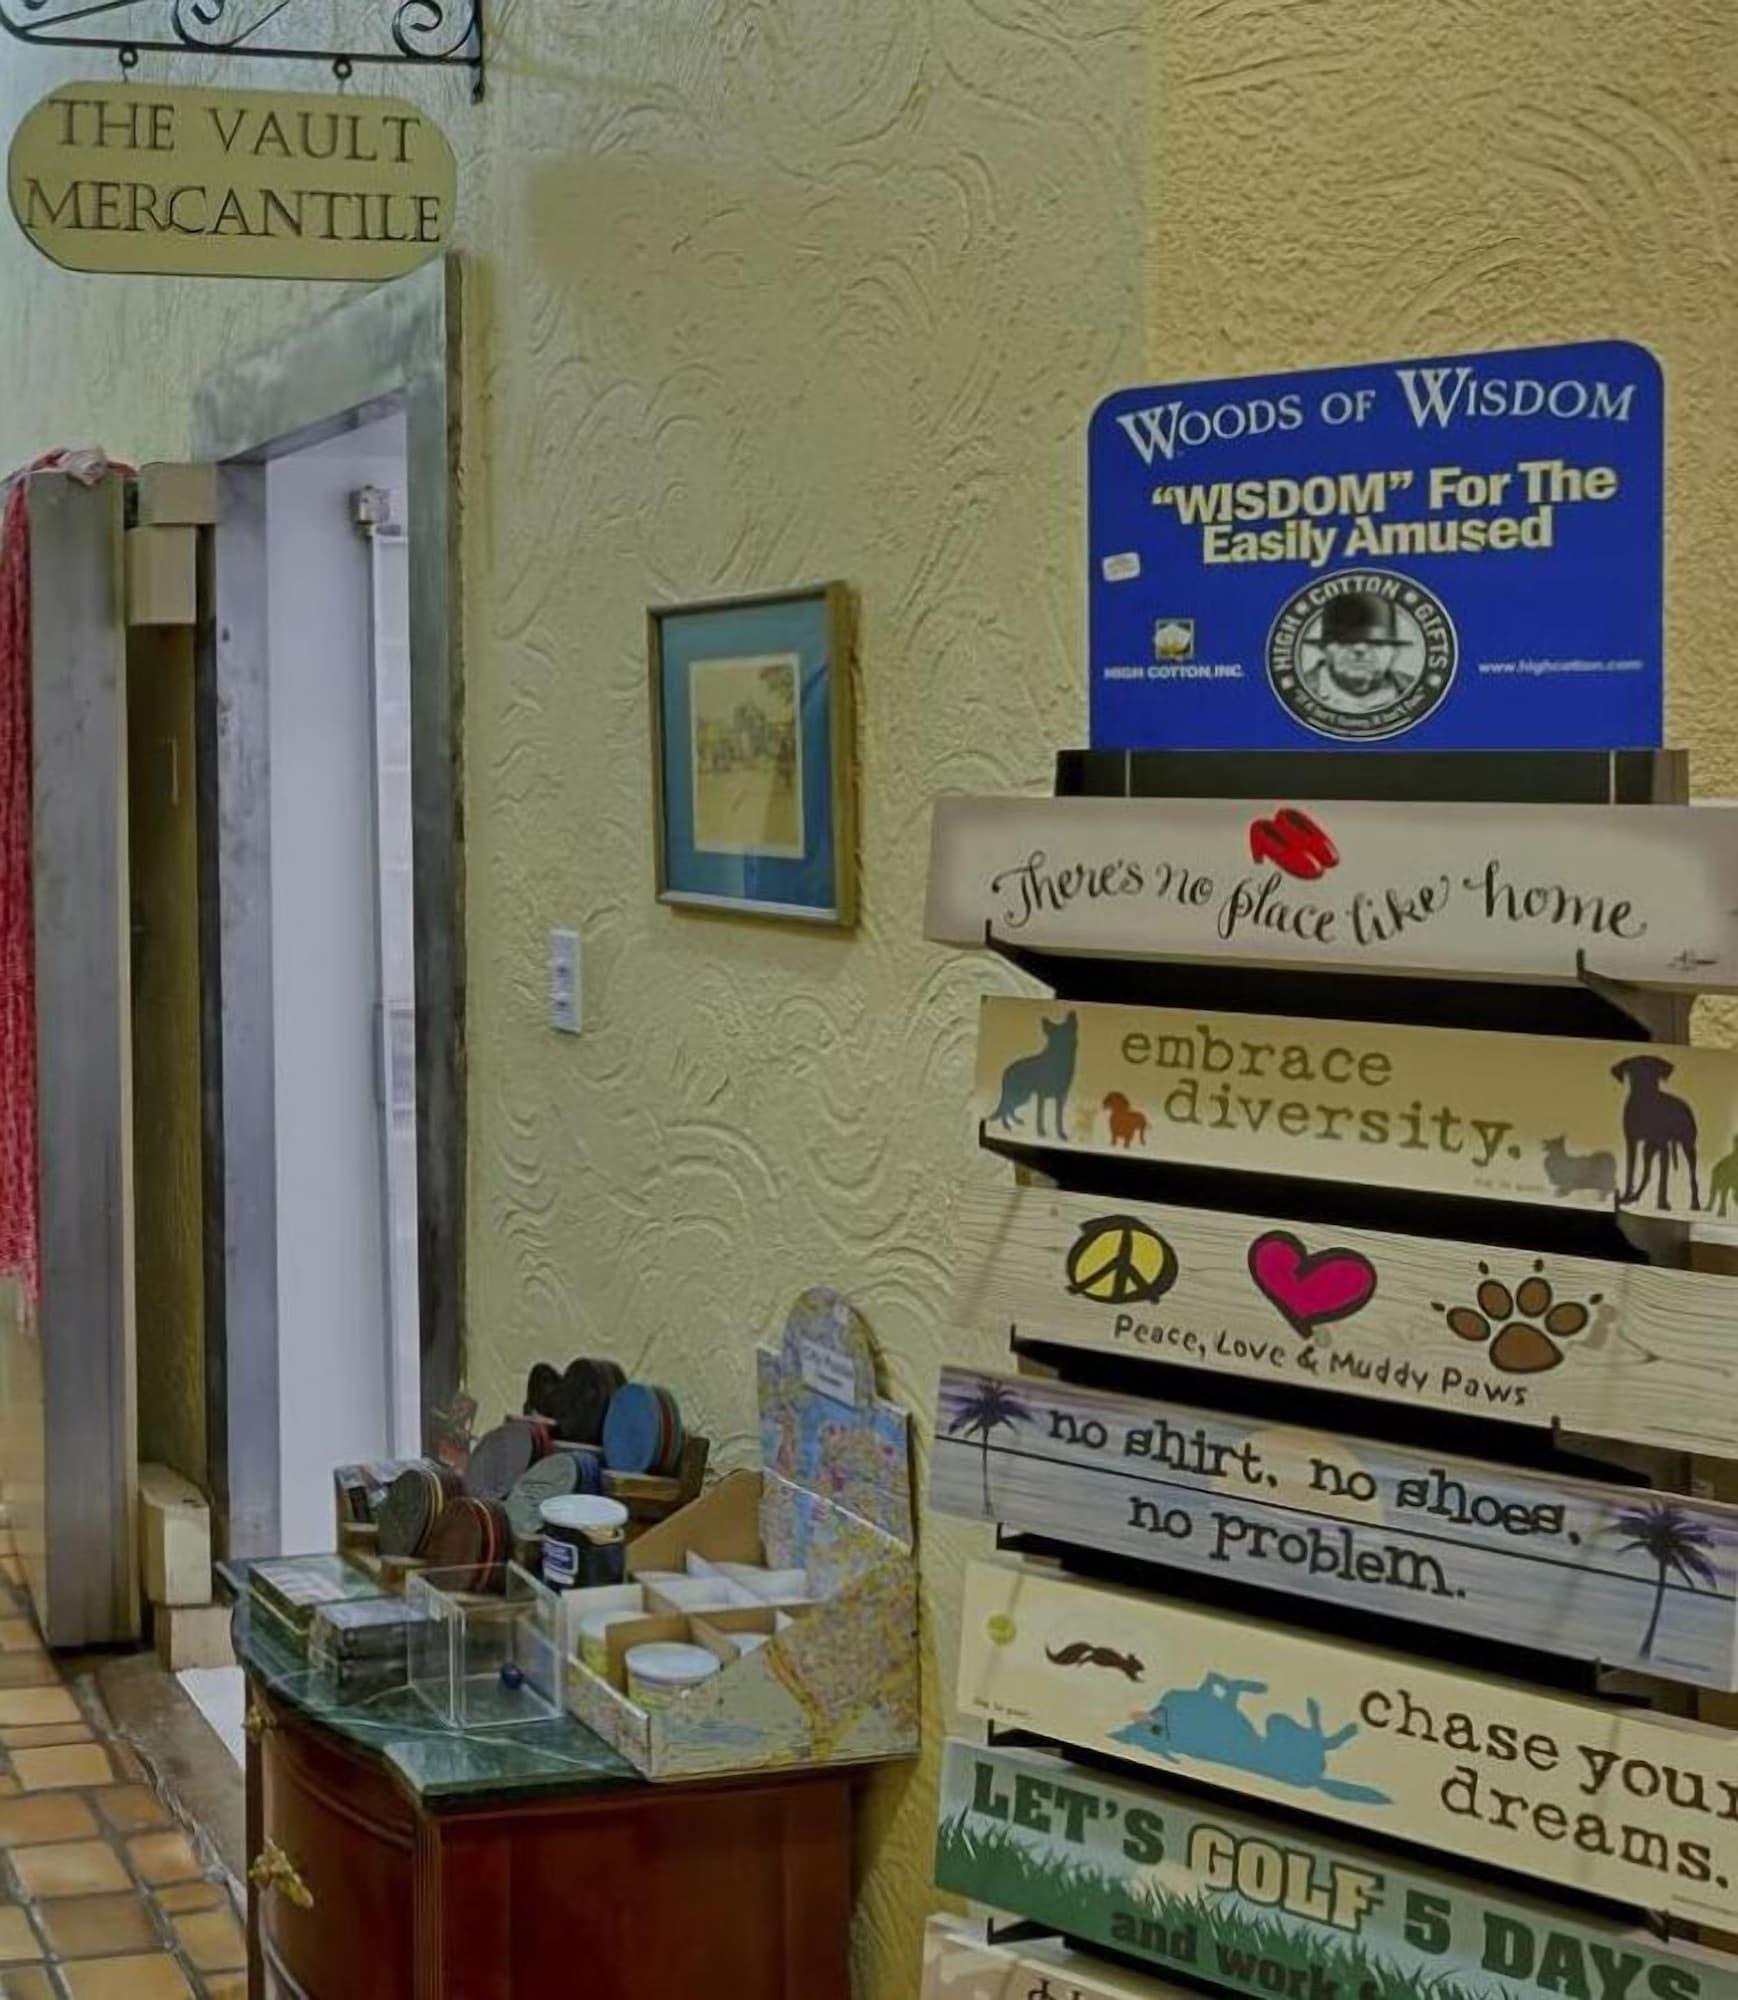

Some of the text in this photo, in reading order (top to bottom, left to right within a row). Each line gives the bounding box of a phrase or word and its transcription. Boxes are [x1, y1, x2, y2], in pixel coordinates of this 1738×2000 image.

[49, 99, 420, 163] THE VAULT
[23, 178, 440, 243] MERCANTILE
[1116, 366, 1636, 466] WOODS OF WISDOM
[1428, 466, 1511, 510] For
[1517, 459, 1617, 504] The
[1203, 506, 1553, 568] Easily Amused
[1272, 575, 1449, 672] HIGH COTTON GIFTS
[992, 851, 1647, 947] There's no place like home
[1121, 1026, 1392, 1086] embrace
[1164, 1078, 1521, 1167] diversity.
[1114, 1313, 1527, 1405] Peace, Love & Muddy Paws
[1048, 1410, 1107, 1449] no
[1308, 1454, 1377, 1502] no
[1128, 1495, 1466, 1598] no problem.
[1359, 1687, 1559, 1771] chase
[972, 1763, 1164, 1865] LET'S
[1187, 1824, 1384, 1934] GOLF
[1405, 1890, 1451, 1955] 5
[1441, 1766, 1728, 1888] dreams.
[1111, 1911, 1340, 2000] and work
